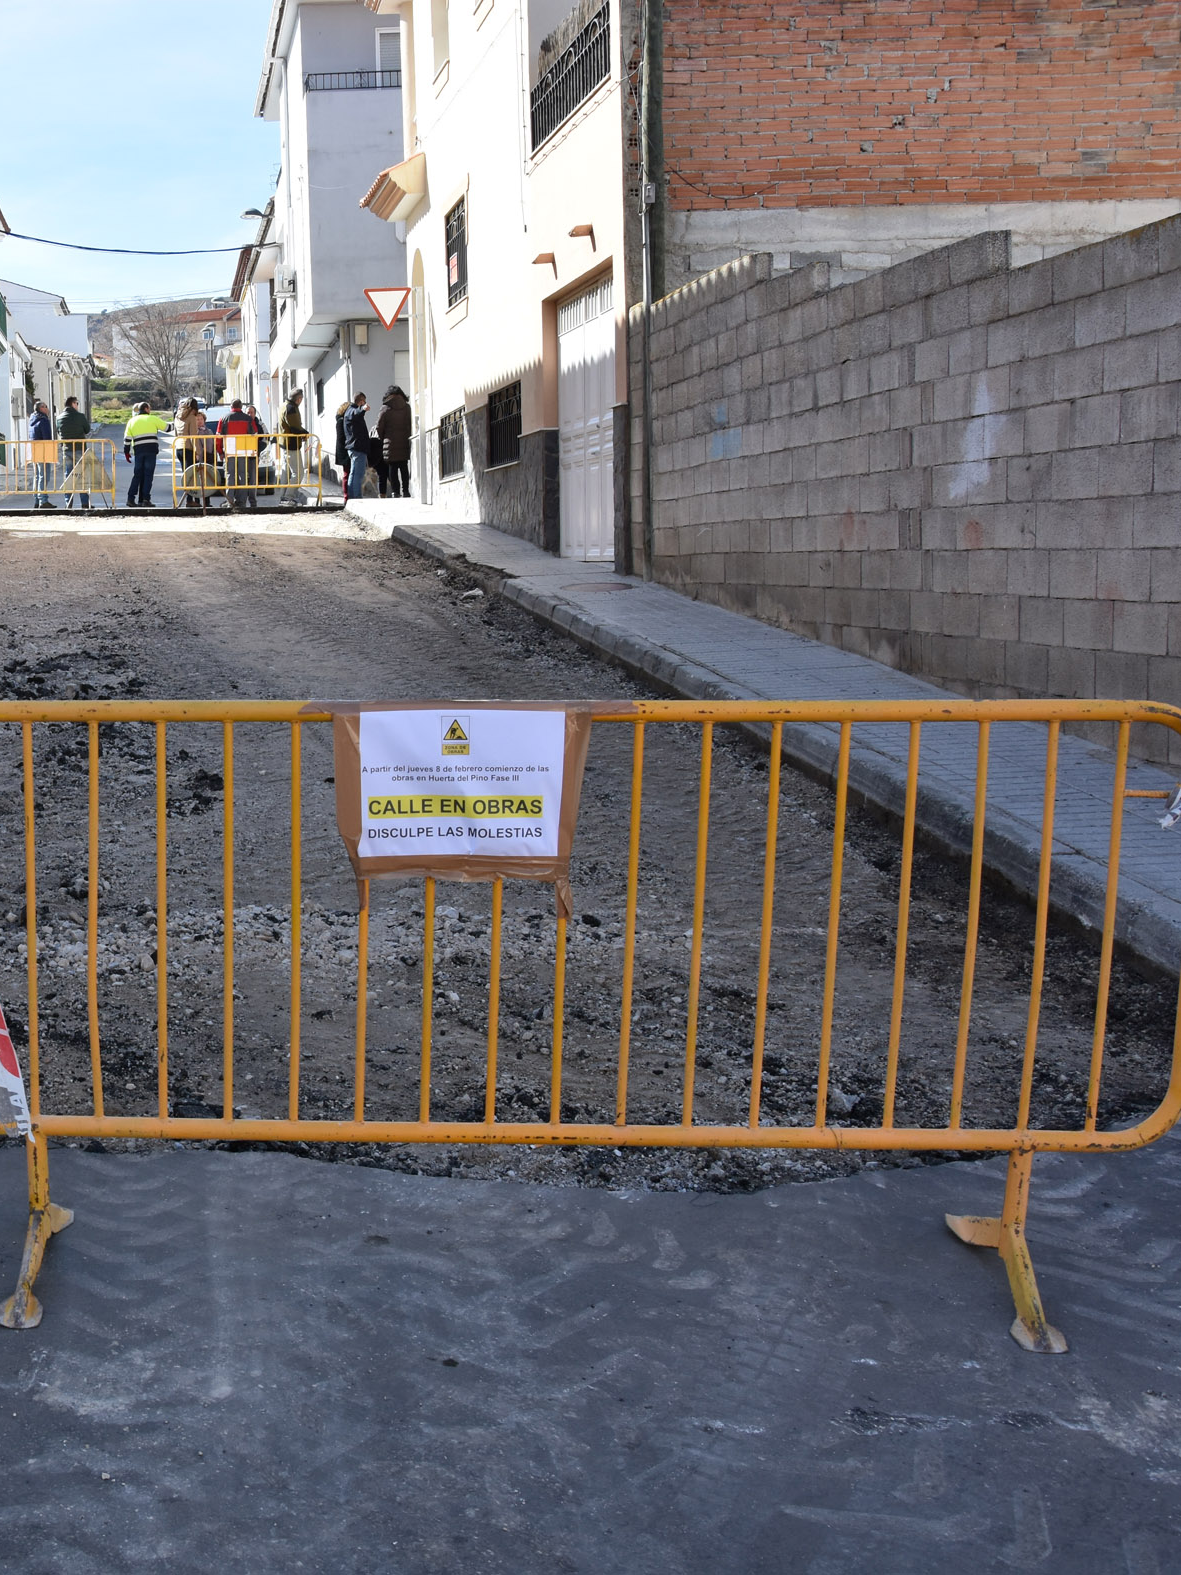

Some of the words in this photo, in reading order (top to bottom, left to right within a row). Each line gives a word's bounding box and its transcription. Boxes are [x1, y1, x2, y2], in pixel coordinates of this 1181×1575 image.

[370, 765, 391, 774] partir
[407, 765, 434, 774] jueves
[470, 774, 489, 782] Pino
[490, 774, 510, 782] Fase
[368, 799, 433, 815] CALLE
[440, 799, 466, 814] EN
[472, 799, 542, 815] OBRAS
[368, 827, 434, 839] DISCULPE
[437, 826, 464, 837] LAS
[467, 827, 543, 838] MOLESTIAS
